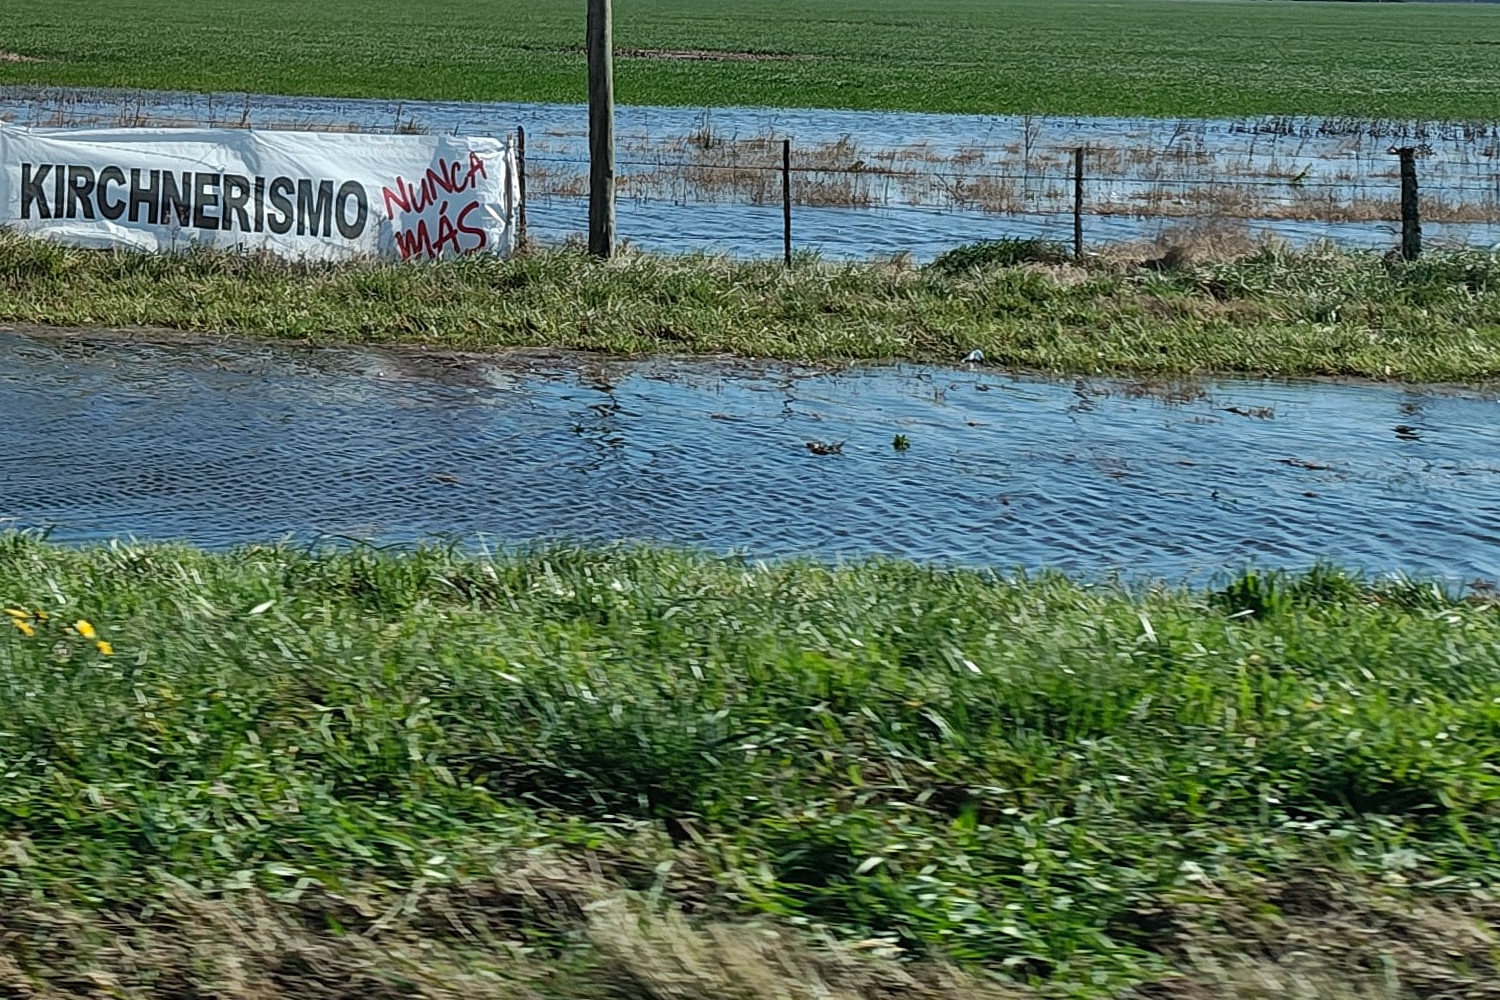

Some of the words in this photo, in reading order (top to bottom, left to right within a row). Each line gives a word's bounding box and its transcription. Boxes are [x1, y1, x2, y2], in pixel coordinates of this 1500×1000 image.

[20, 162, 368, 240] KIRCHNERISMO
[382, 151, 487, 220] NUNCA
[395, 201, 486, 260] MÁS
